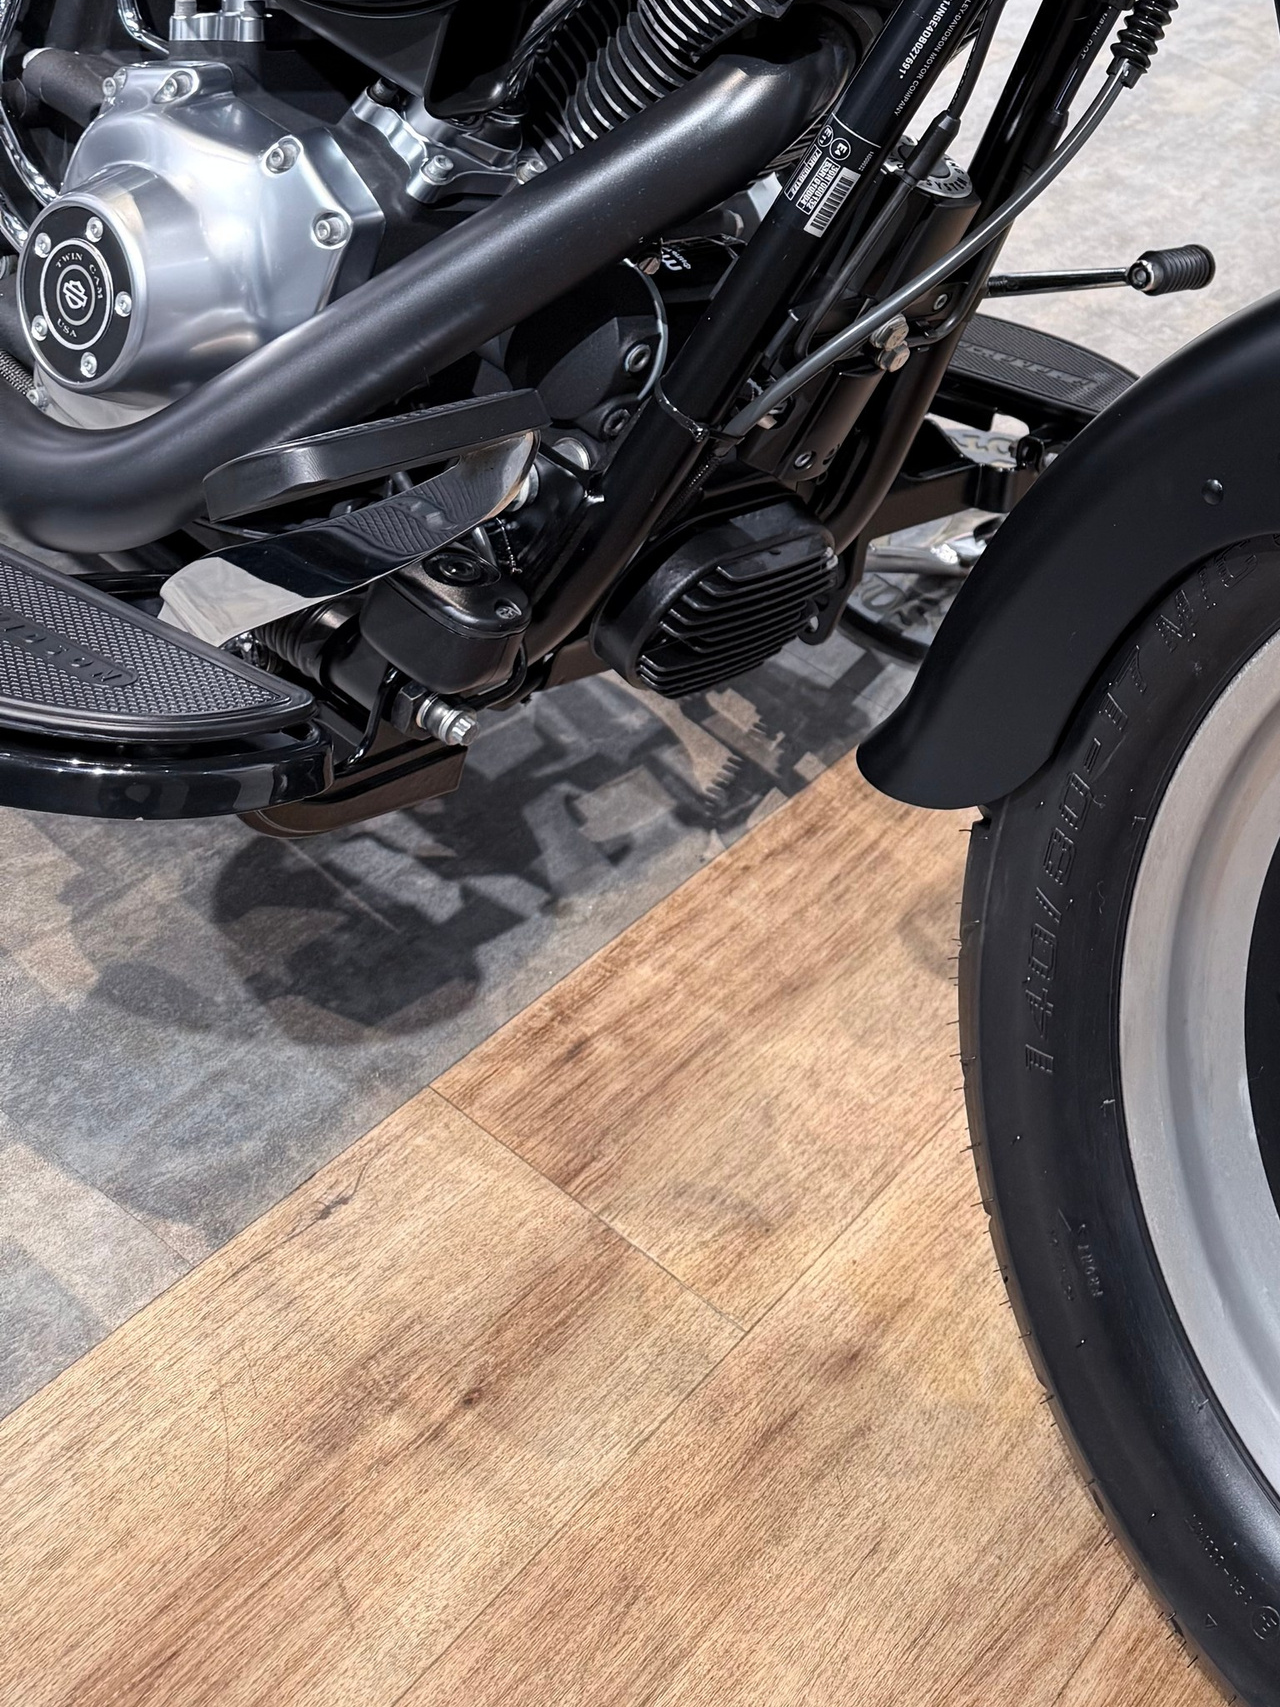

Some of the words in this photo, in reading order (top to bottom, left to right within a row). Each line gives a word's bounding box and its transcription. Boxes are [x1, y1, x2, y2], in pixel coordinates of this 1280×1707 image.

[915, 50, 937, 80] MOTOR
[892, 78, 920, 117] COMPANY
[55, 251, 83, 269] TWIN
[88, 263, 104, 300] CAM
[56, 317, 78, 338] USA
